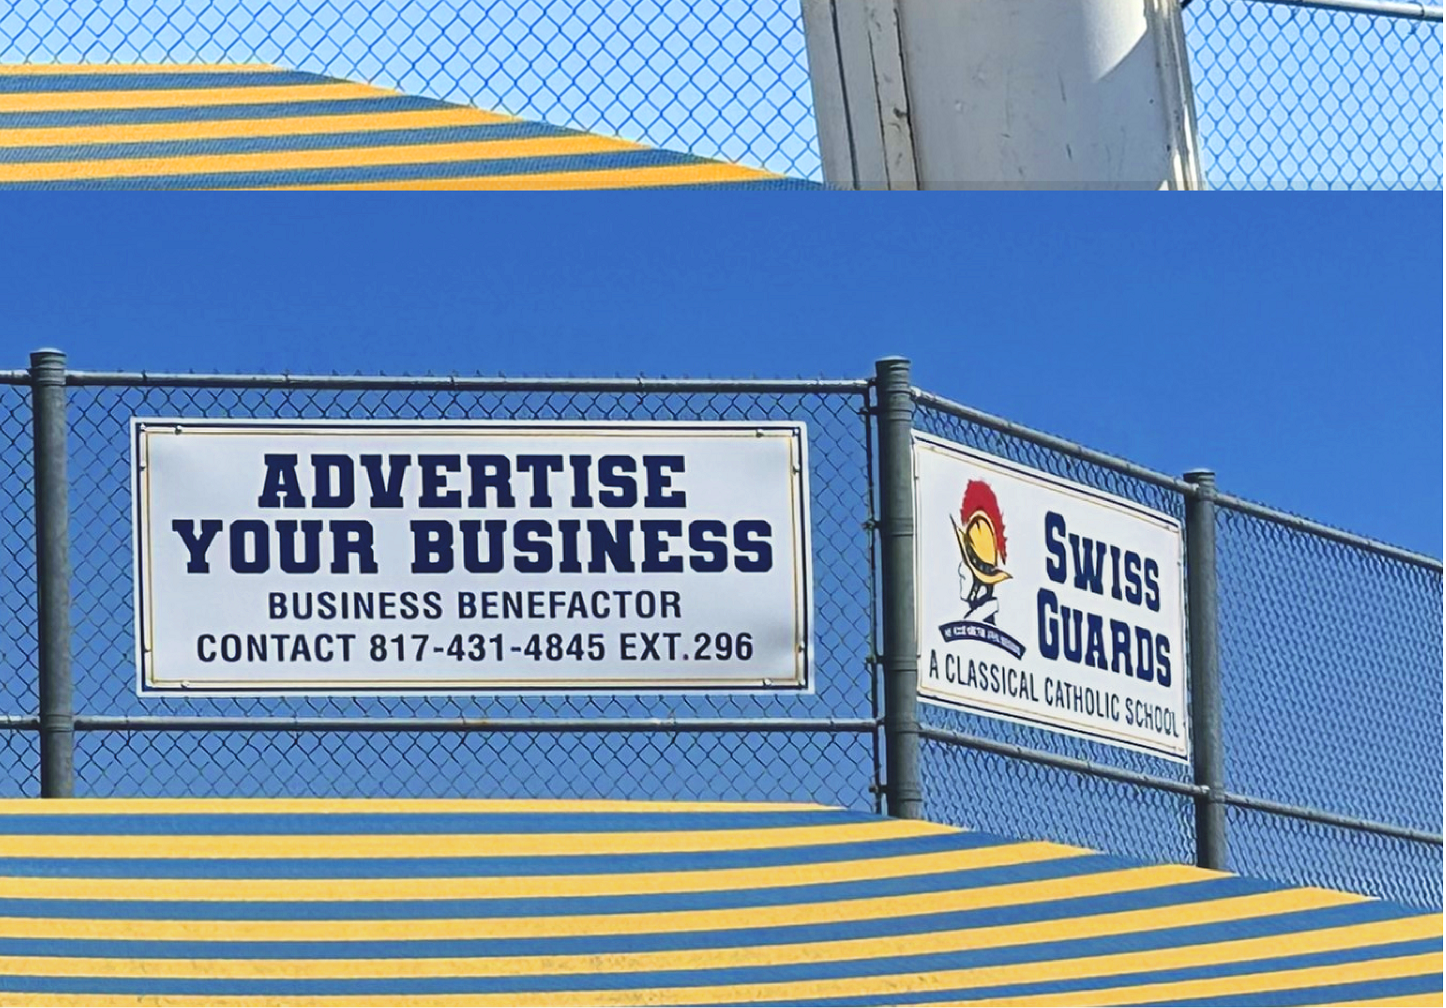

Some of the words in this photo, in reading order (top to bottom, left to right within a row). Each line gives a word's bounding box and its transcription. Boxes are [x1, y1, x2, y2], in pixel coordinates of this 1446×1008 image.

[257, 453, 687, 508] ADVERTISE
[172, 518, 379, 574] YOUR
[411, 518, 774, 574] BUSINESS
[1044, 510, 1160, 612] SWISS
[267, 590, 443, 620] BUSINESS
[457, 590, 682, 620] BENEFACTOR
[196, 633, 356, 663] CONTACT
[369, 632, 605, 662] 817-431-4845
[1037, 587, 1171, 687] GUARDS
[929, 649, 939, 680] A
[945, 654, 1039, 702] CLASSICAL
[1044, 677, 1120, 721] CATHOLIC
[1125, 697, 1179, 738] SCHOOL
